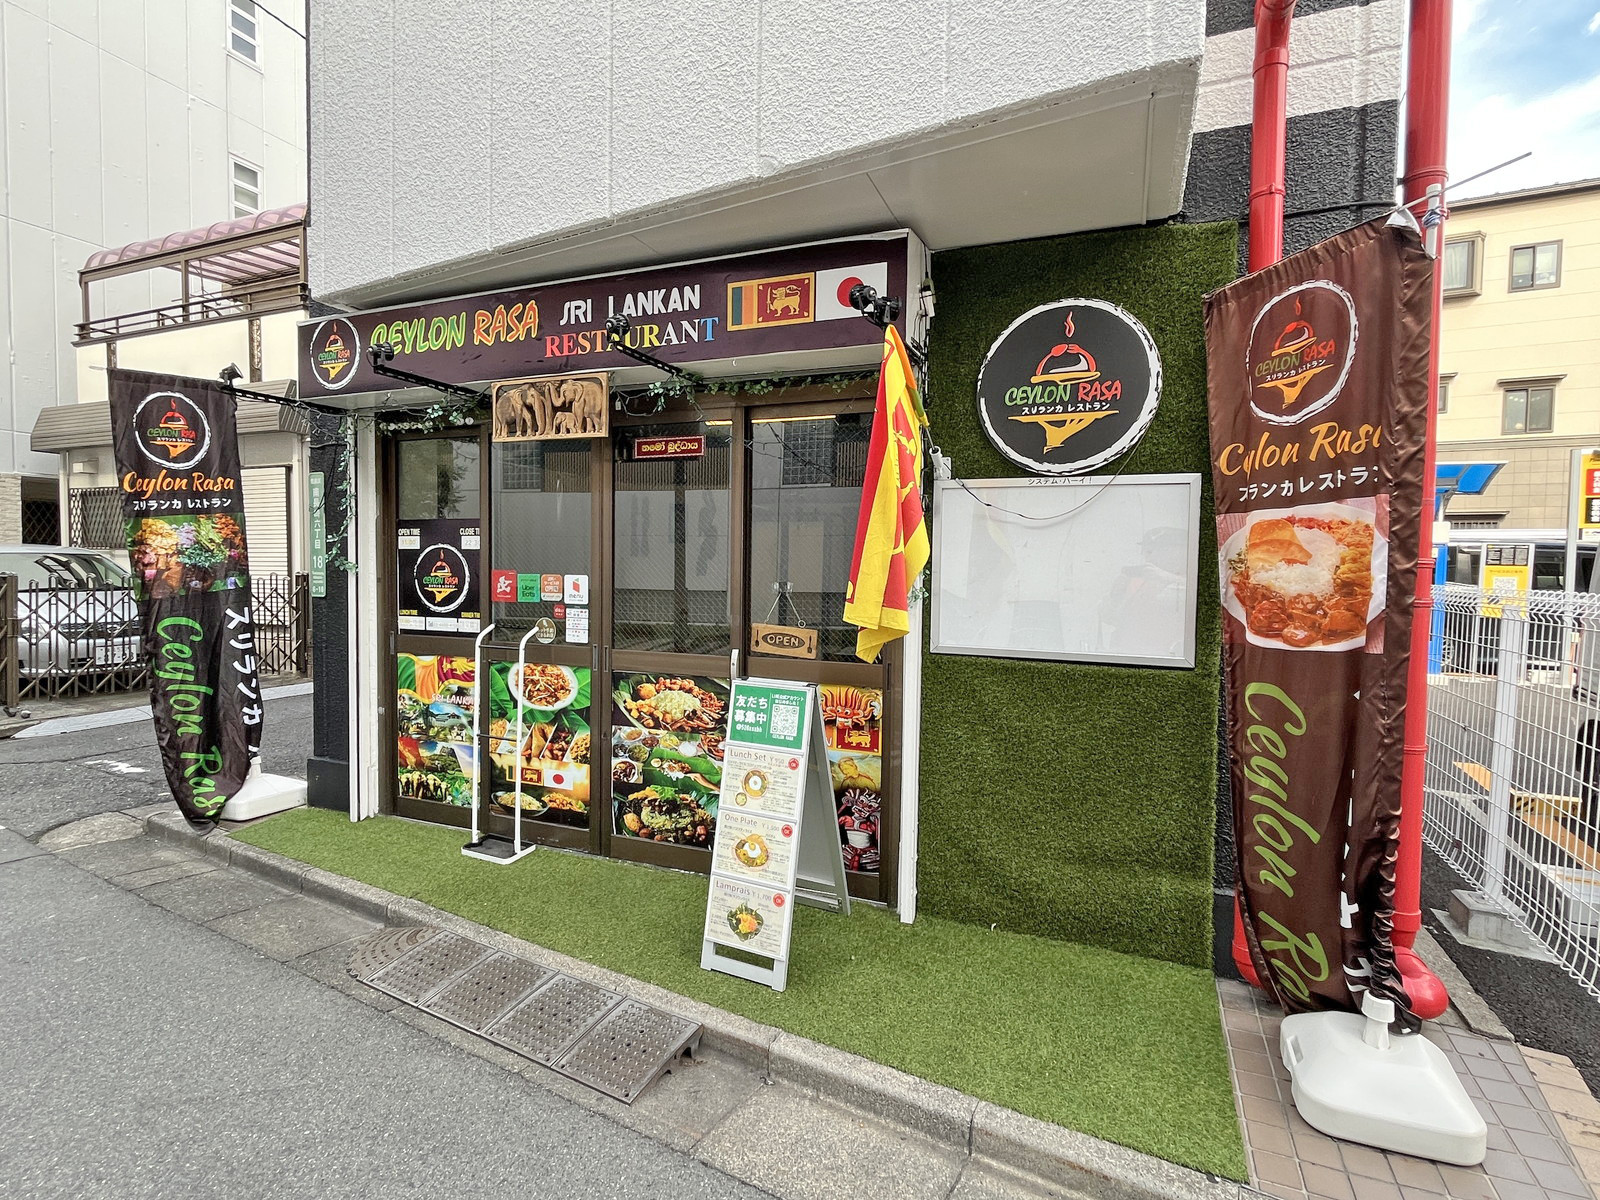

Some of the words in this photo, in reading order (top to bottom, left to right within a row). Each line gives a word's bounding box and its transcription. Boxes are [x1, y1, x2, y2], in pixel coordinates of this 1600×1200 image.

[559, 298, 593, 326] SRI
[607, 284, 701, 318] LANKAN
[370, 311, 467, 355] CEYLON
[473, 300, 539, 346] RASA
[1255, 353, 1300, 377] CEYLON
[1005, 383, 1071, 406] CEYLON
[1078, 380, 1122, 402] RASA
[122, 469, 188, 500] Ceylon
[192, 471, 235, 492] Rasa
[312, 555, 323, 569] 18
[767, 634, 799, 647] OPEN
[152, 616, 214, 737] Ceylon
[431, 693, 444, 703] SRI
[735, 694, 768, 709] 友だち
[734, 709, 767, 725] 募集中
[730, 749, 752, 759] Lunch
[754, 752, 766, 761] Set
[1244, 682, 1321, 898] Ceylon
[724, 813, 739, 823] One
[740, 816, 758, 827] Plate
[716, 880, 750, 896] Lamprais
[1258, 910, 1330, 1003] Ra
